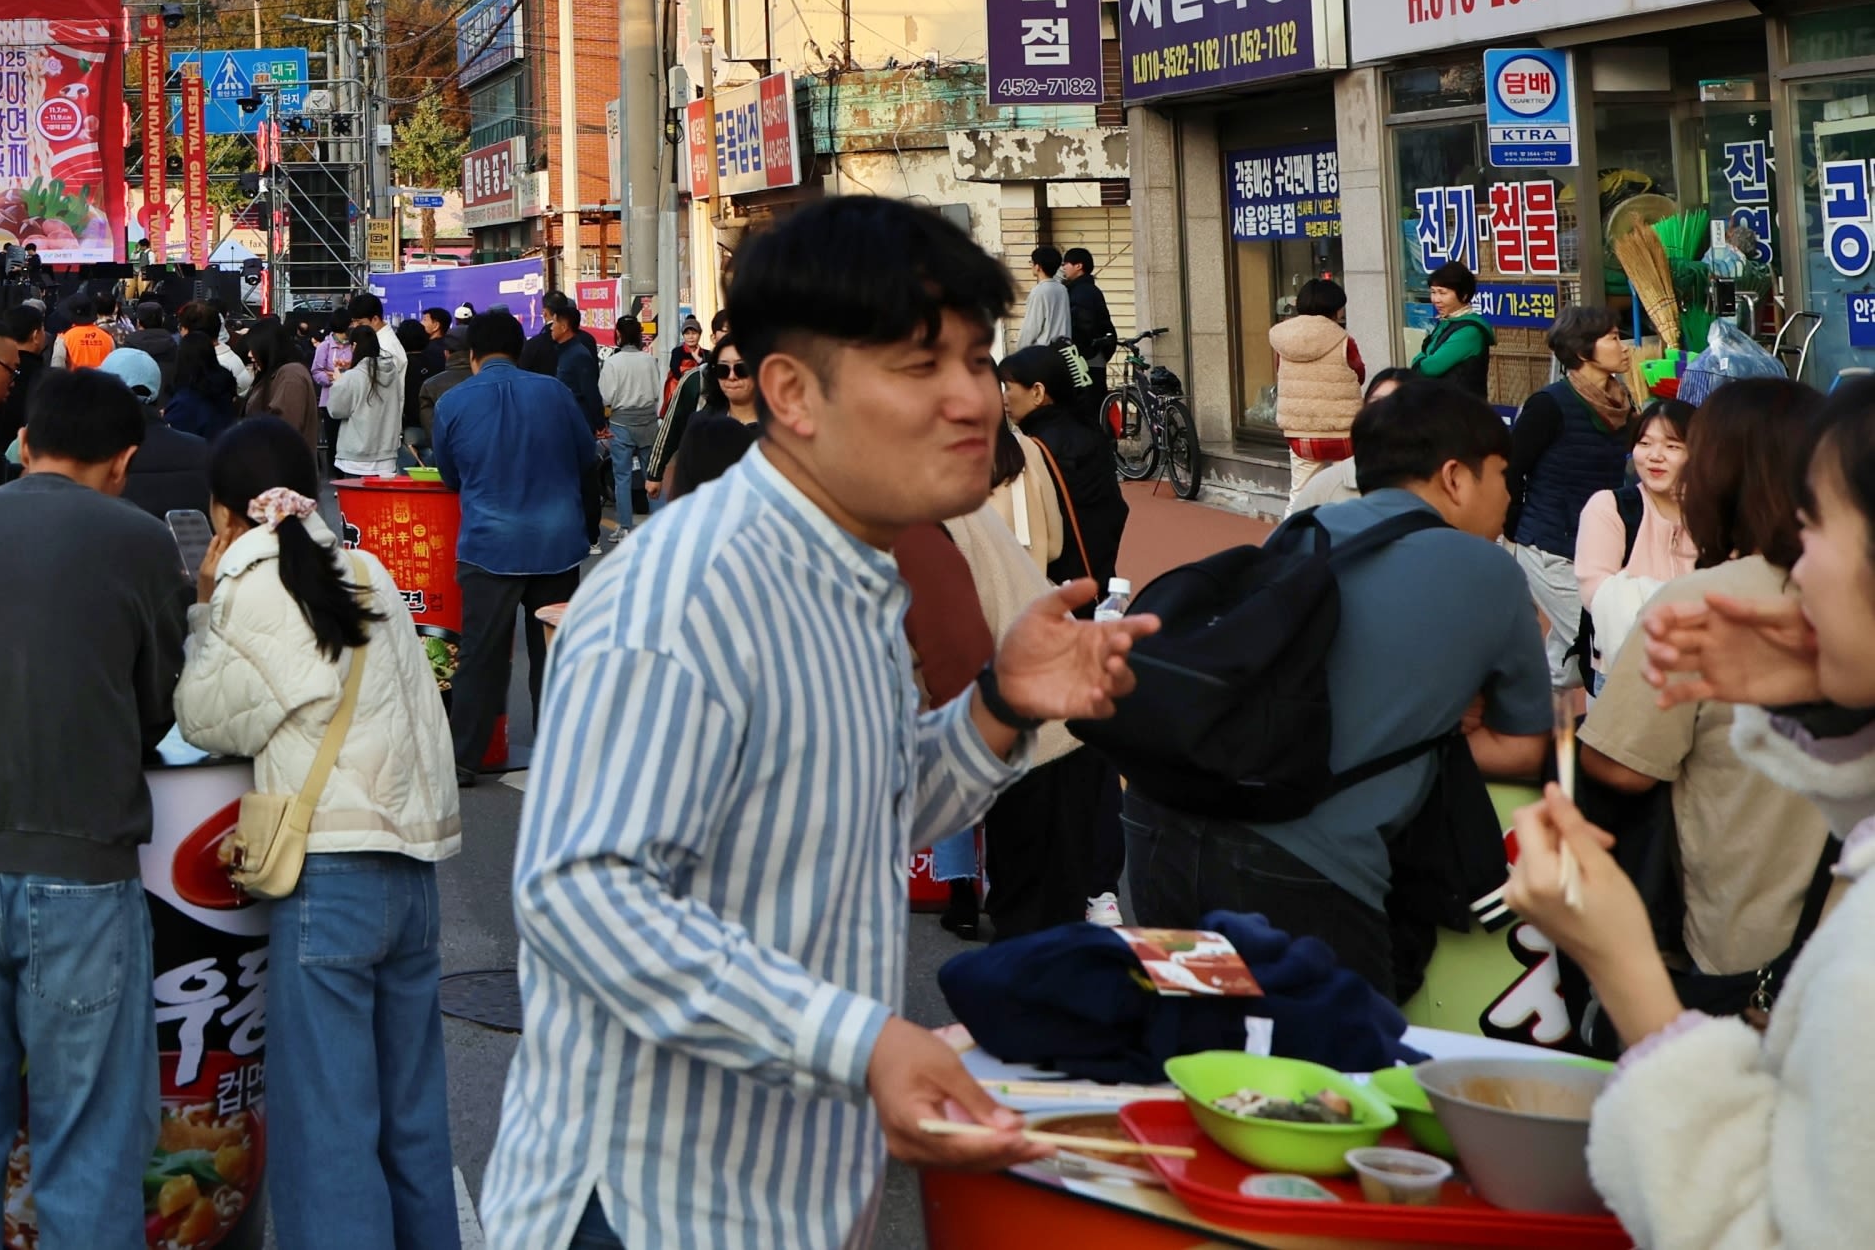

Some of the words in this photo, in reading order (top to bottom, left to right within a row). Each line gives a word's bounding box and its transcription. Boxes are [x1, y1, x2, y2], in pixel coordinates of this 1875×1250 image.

[147, 36, 159, 106] FESTIVAL
[272, 62, 297, 77] 대구
[1131, 32, 1221, 86] H.010-3522-7182
[1230, 20, 1299, 69] T.452-7182
[997, 76, 1097, 97] 452-7182
[1504, 72, 1551, 95] 담배
[148, 106, 160, 166] RAMYUN
[187, 85, 200, 155] FESTIVAL
[1502, 129, 1558, 141] KTRA
[148, 166, 160, 206] GUMI
[189, 160, 201, 198] GUMI
[1234, 157, 1273, 200] 각종미싱
[1274, 153, 1315, 197] 수리판매
[189, 198, 202, 259] RAMYUN
[1233, 202, 1297, 237] 서울양복점
[1822, 158, 1875, 277] 공
[1505, 292, 1556, 319] 가스주입
